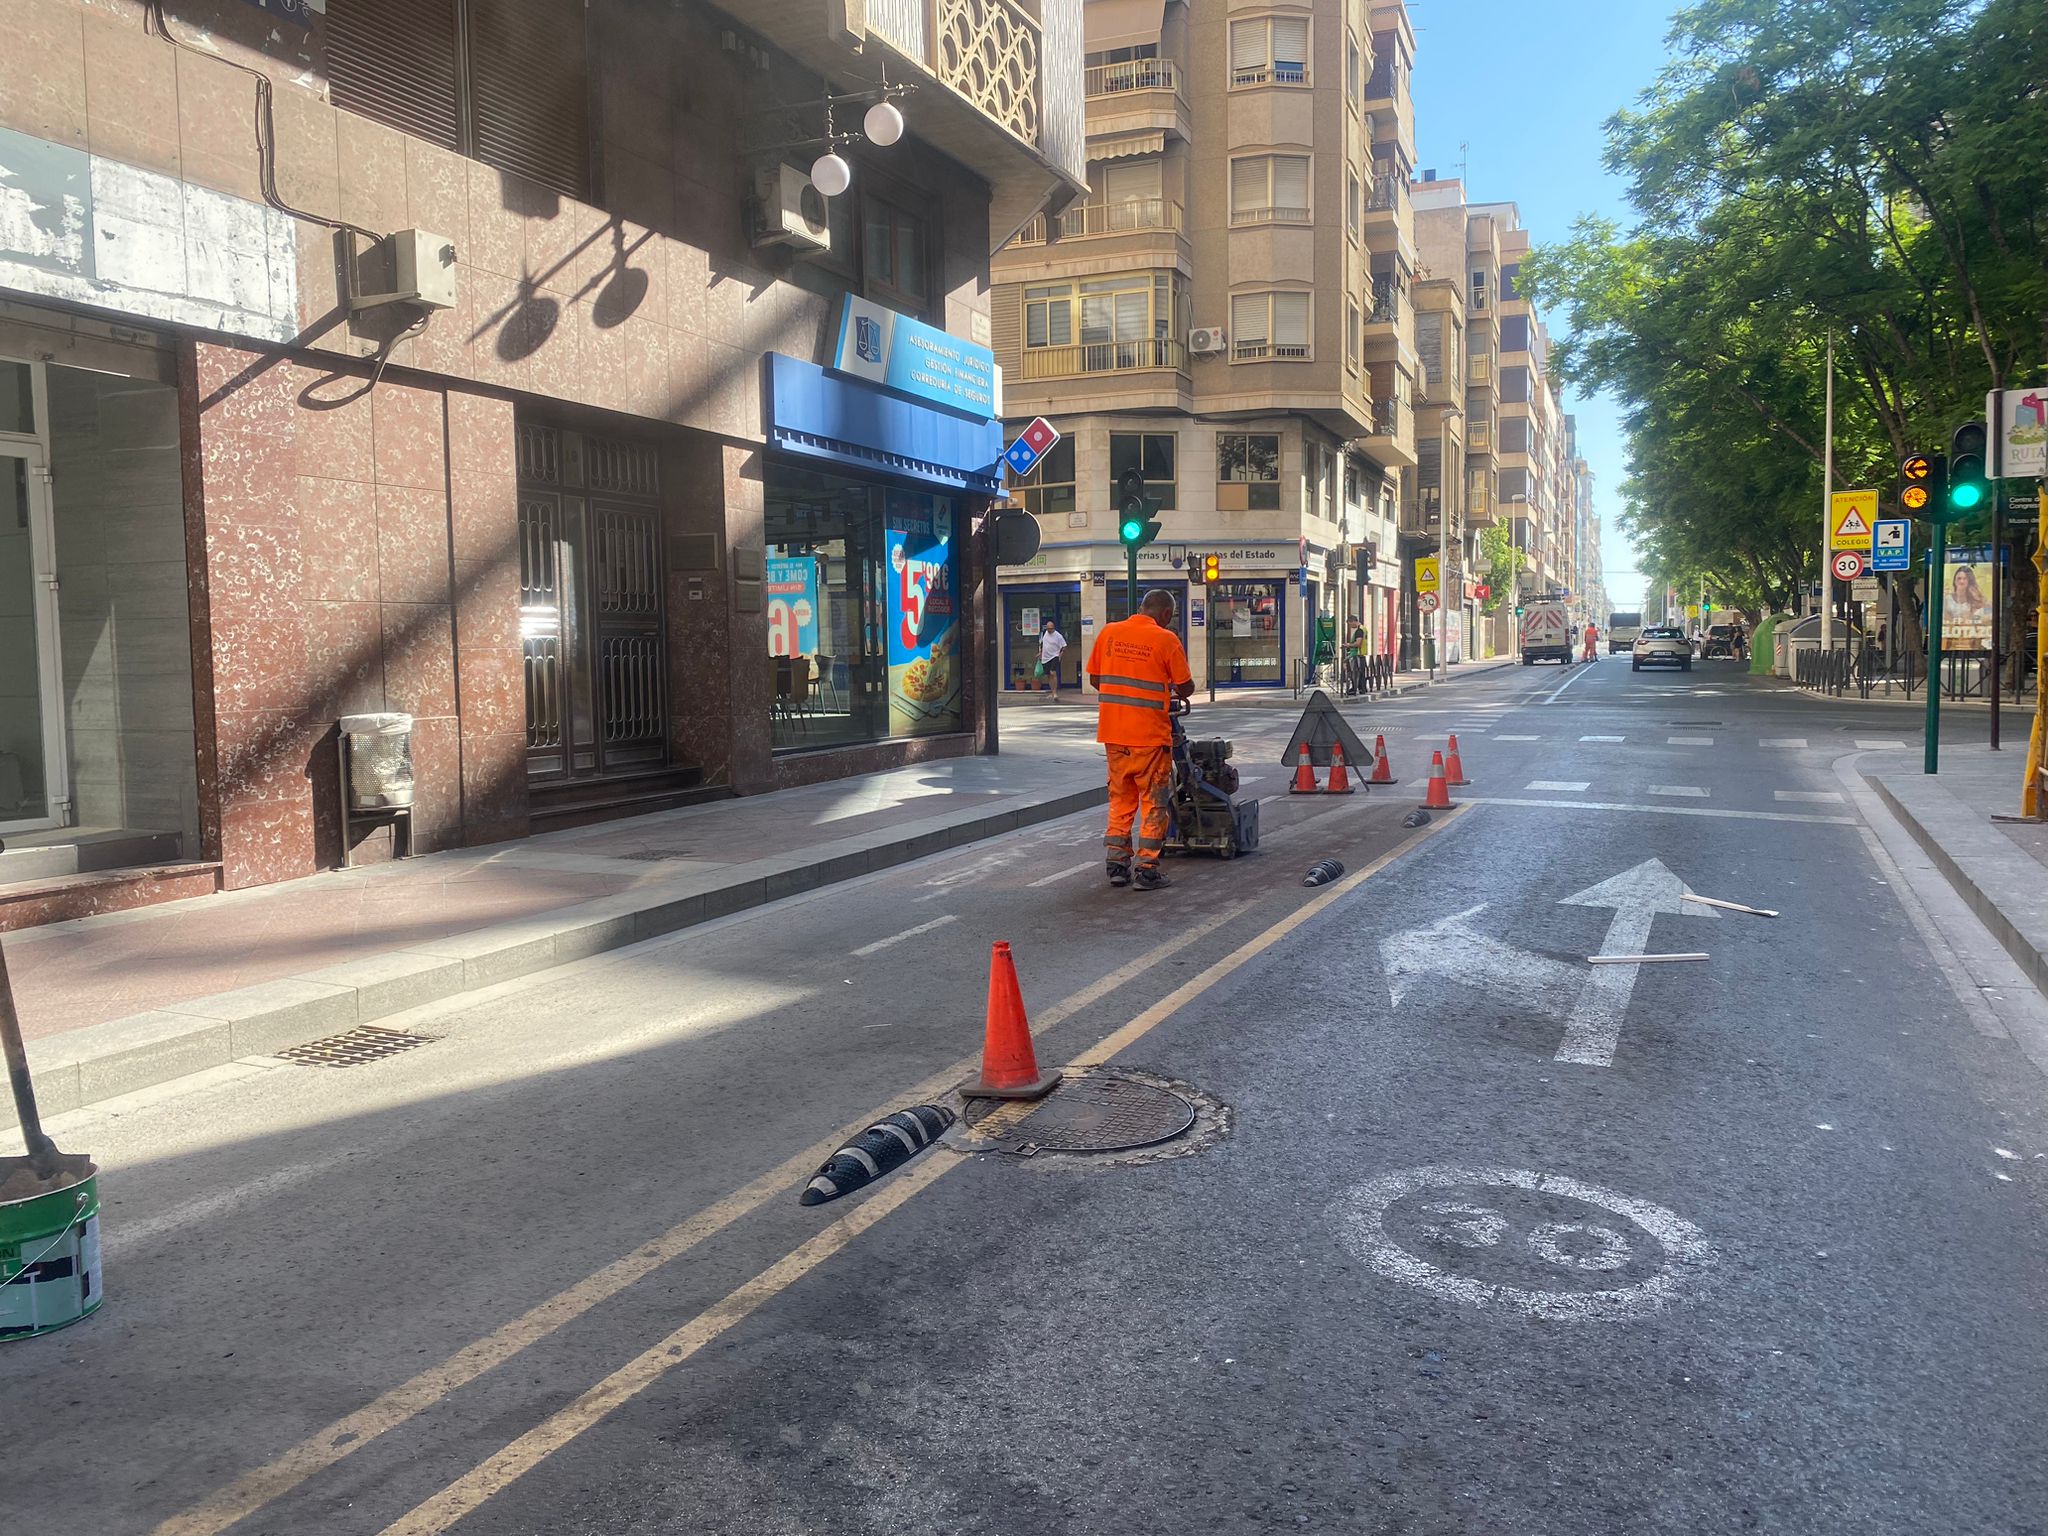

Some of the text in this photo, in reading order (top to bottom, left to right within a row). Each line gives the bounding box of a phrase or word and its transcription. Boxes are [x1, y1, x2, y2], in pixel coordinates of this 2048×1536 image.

[909, 335, 960, 362] ASESORAMIENTO
[955, 367, 988, 389] FINANCIERA
[953, 384, 961, 396] DE
[963, 388, 990, 406] SEGUROS
[2011, 446, 2046, 461] RUTA
[1835, 494, 1873, 503] ATENCIÓN
[892, 516, 902, 530] SIN
[903, 518, 930, 535] SECRETOS
[1123, 551, 1160, 560] Lerías
[1161, 552, 1167, 562] y
[1230, 550, 1243, 559] del
[1245, 550, 1275, 559] Estado
[1838, 560, 1857, 571] 30
[1420, 1202, 1633, 1271] 30
